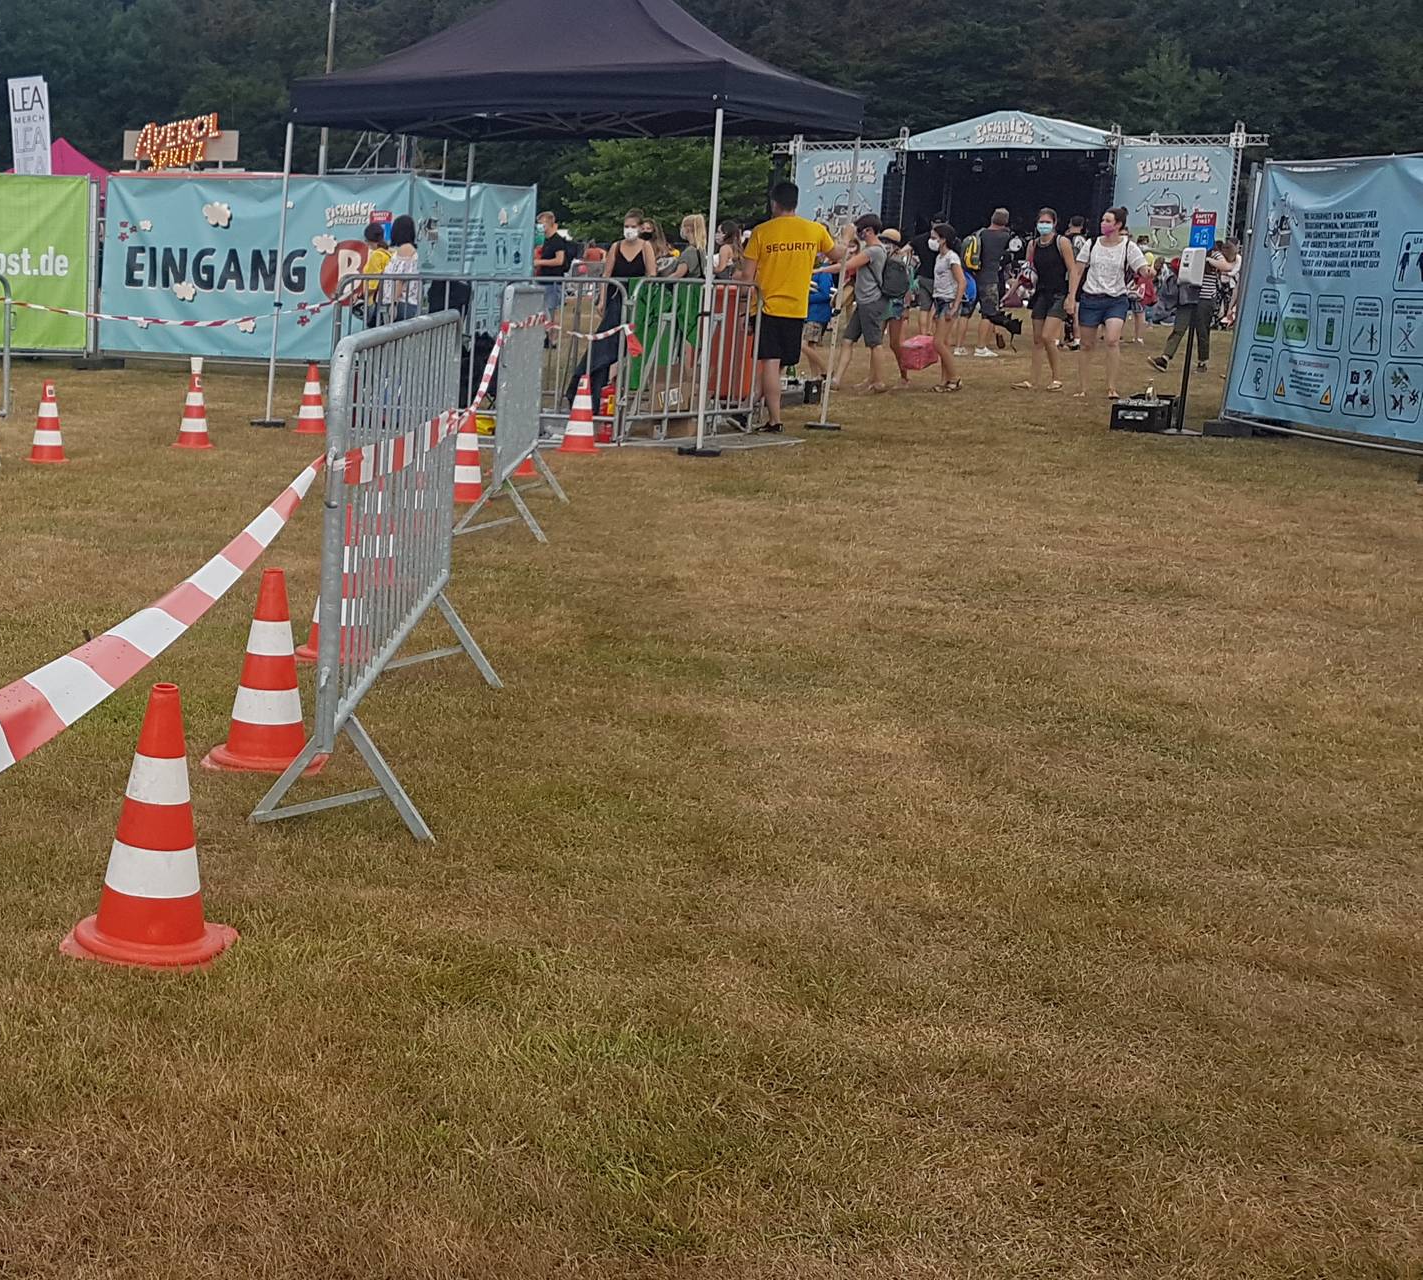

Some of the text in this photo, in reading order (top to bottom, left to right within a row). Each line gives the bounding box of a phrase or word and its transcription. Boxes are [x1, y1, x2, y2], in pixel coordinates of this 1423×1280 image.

[11, 86, 44, 112] LEA
[14, 114, 45, 124] MERCH
[14, 126, 47, 153] LEA
[135, 112, 222, 158] APEROL
[147, 140, 207, 172] SPRITZ
[766, 242, 817, 254] SECURITY
[124, 246, 308, 293] EINGANG
